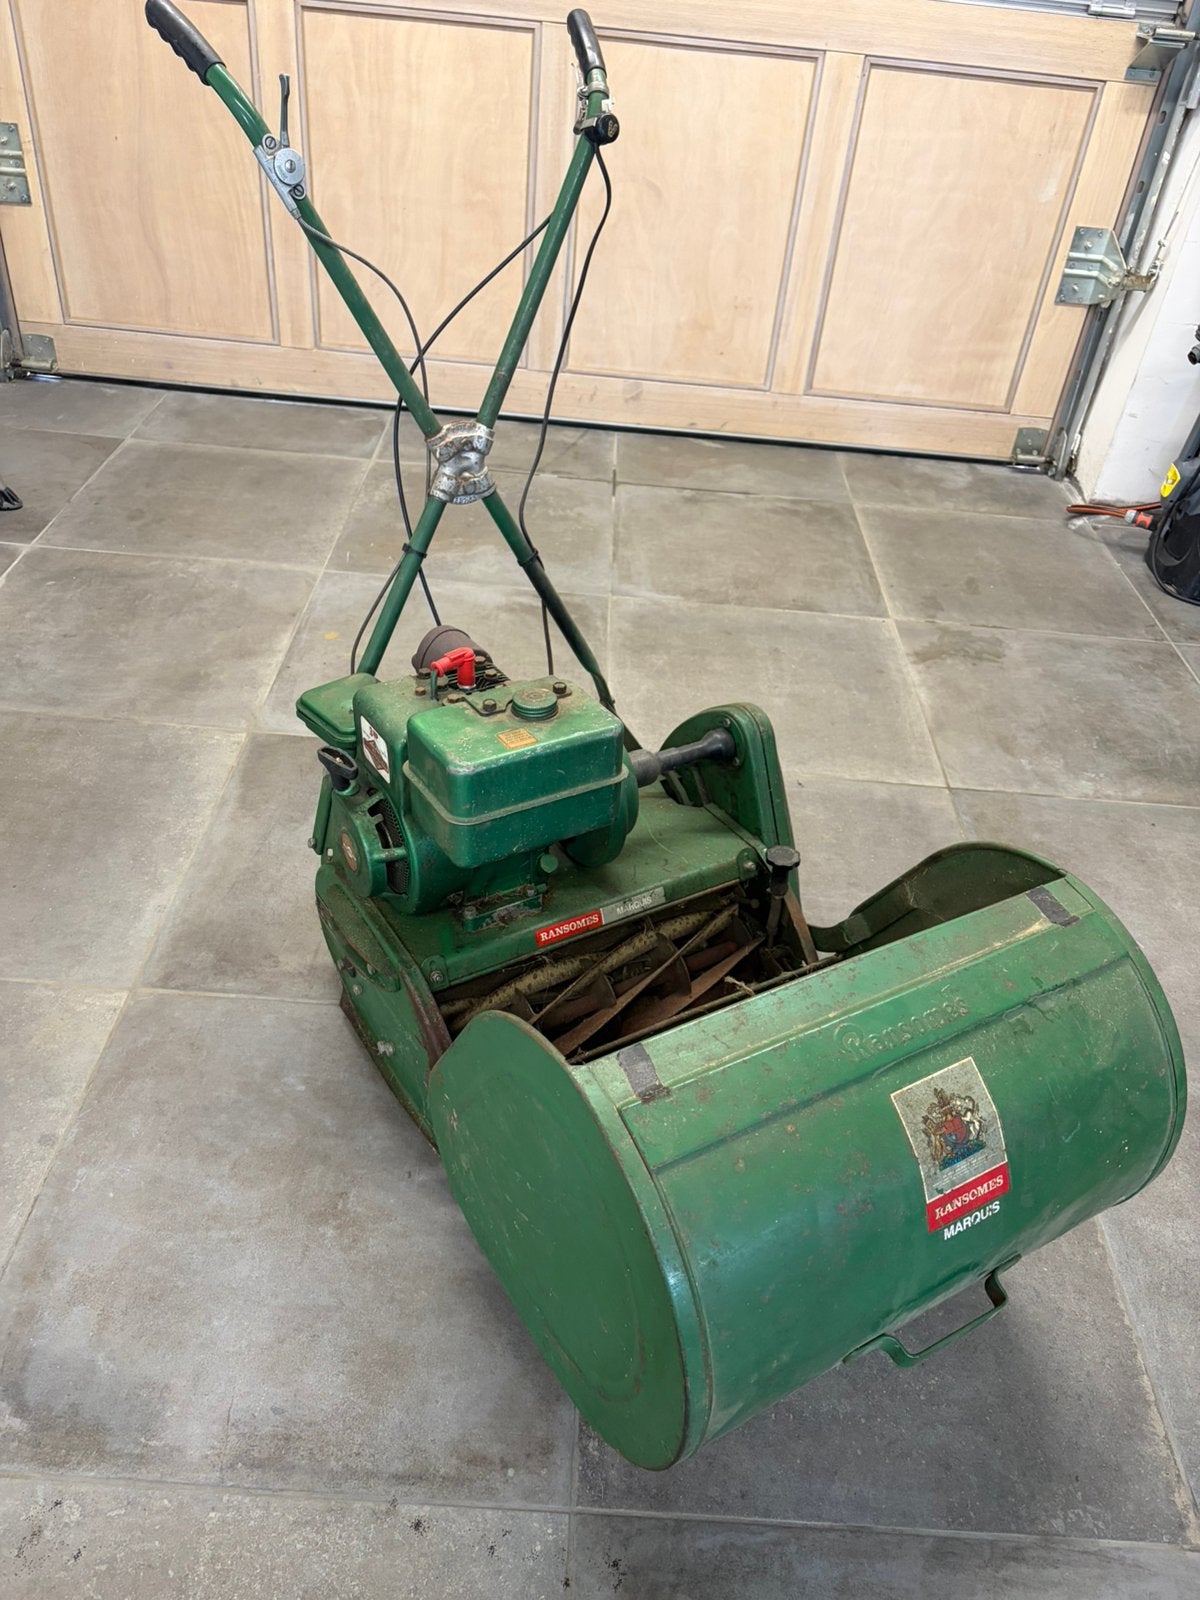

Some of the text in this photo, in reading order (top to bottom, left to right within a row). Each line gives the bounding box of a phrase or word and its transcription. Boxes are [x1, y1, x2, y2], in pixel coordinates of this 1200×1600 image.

[540, 896, 653, 942] RANSOMES MARQUIS
[935, 1174, 1004, 1220] RANSOMES
[943, 1200, 1000, 1241] MARQUIS
